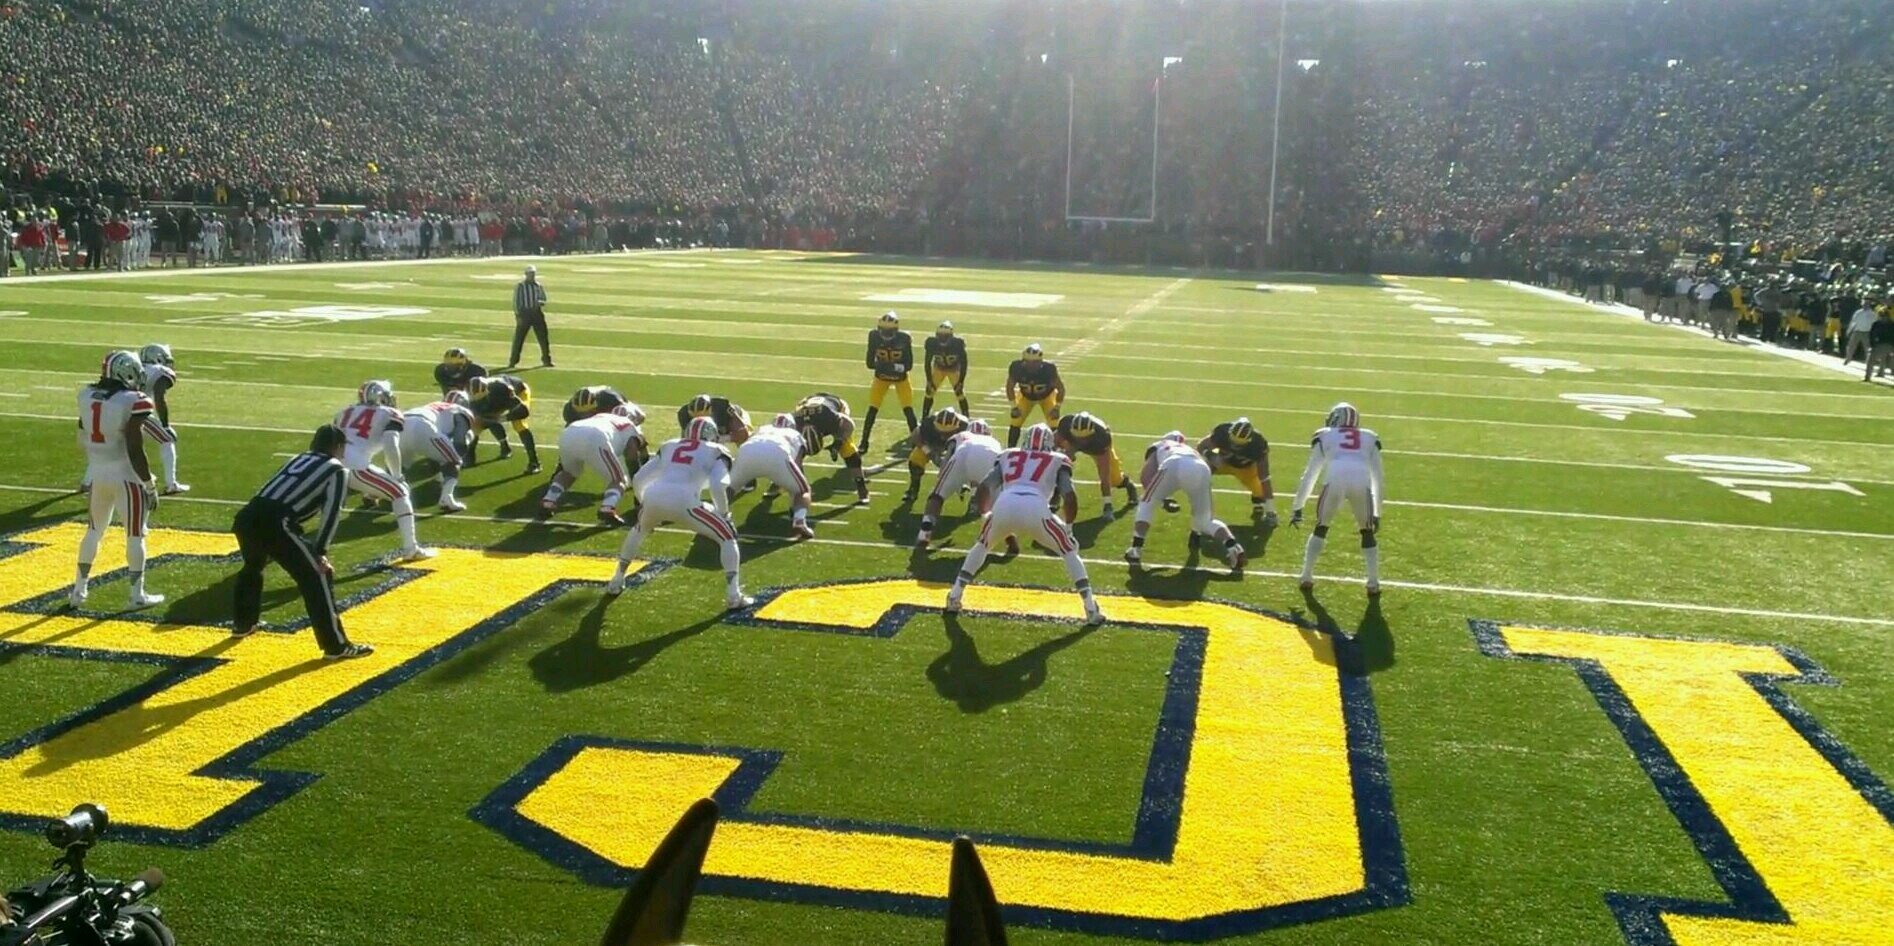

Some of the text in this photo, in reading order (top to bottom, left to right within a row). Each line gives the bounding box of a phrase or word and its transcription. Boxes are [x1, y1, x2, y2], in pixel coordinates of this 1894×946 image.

[90, 400, 106, 443] 1
[340, 407, 377, 440] 14
[671, 438, 701, 465] 2
[1339, 427, 1361, 450] 3
[1004, 450, 1054, 483] 37
